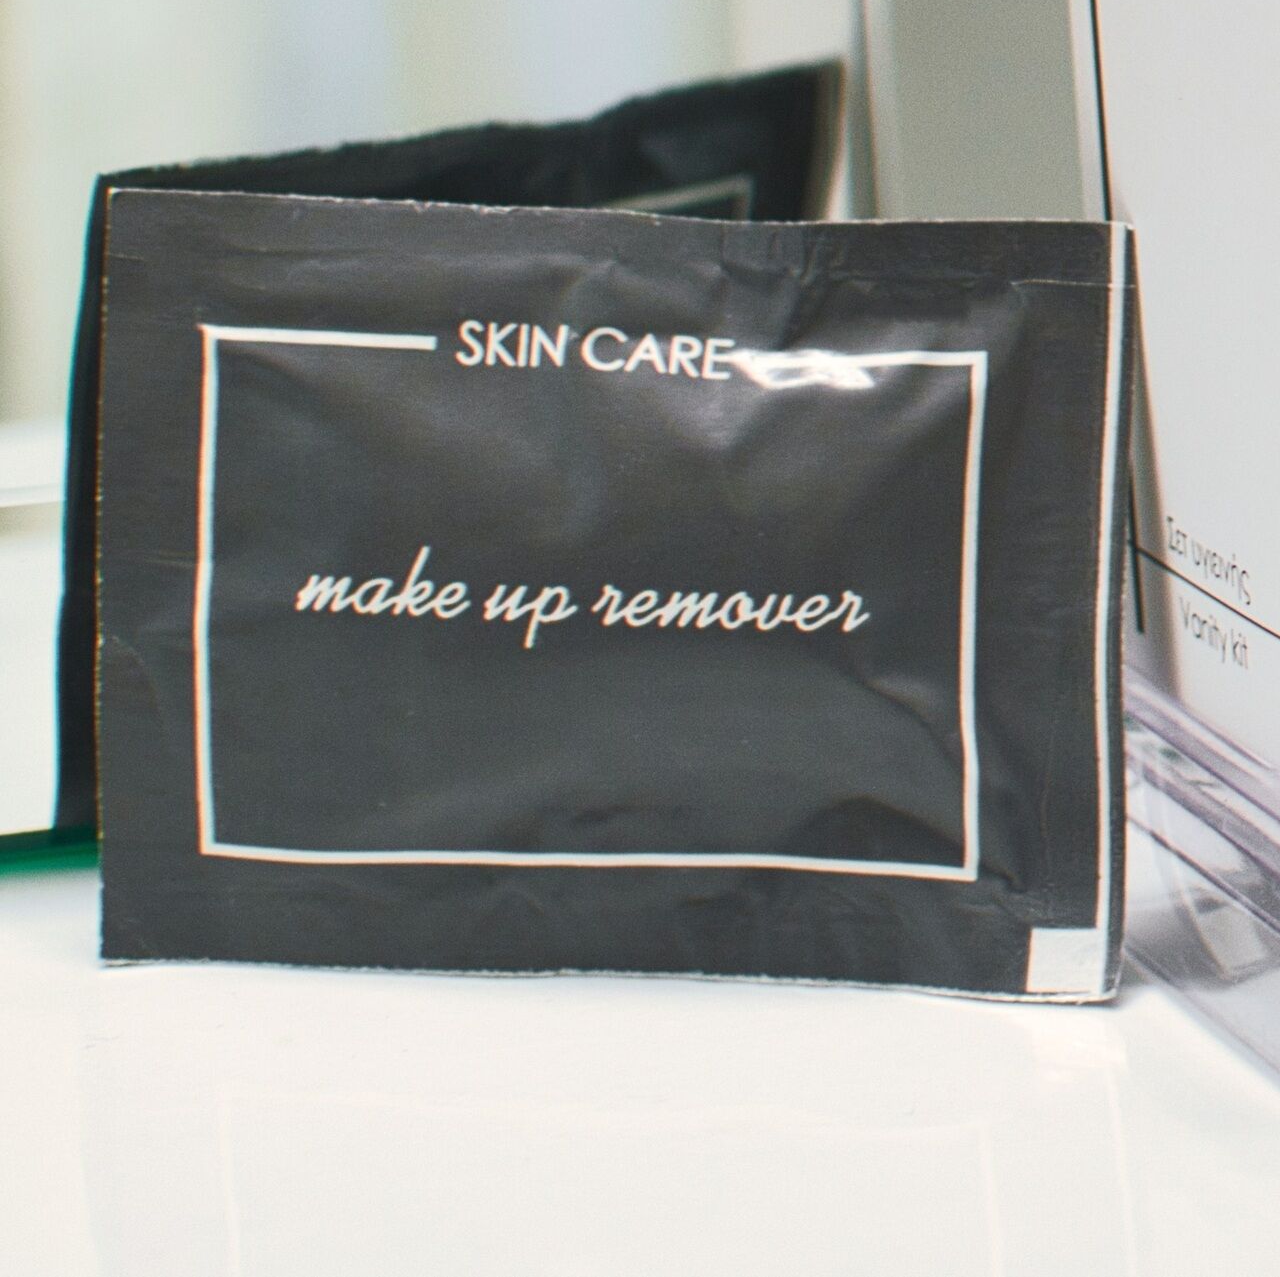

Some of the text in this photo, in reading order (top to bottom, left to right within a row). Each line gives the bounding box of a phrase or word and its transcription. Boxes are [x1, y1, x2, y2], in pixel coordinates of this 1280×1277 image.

[454, 319, 737, 380] SKIN CARE
[295, 544, 872, 649] make up remover
